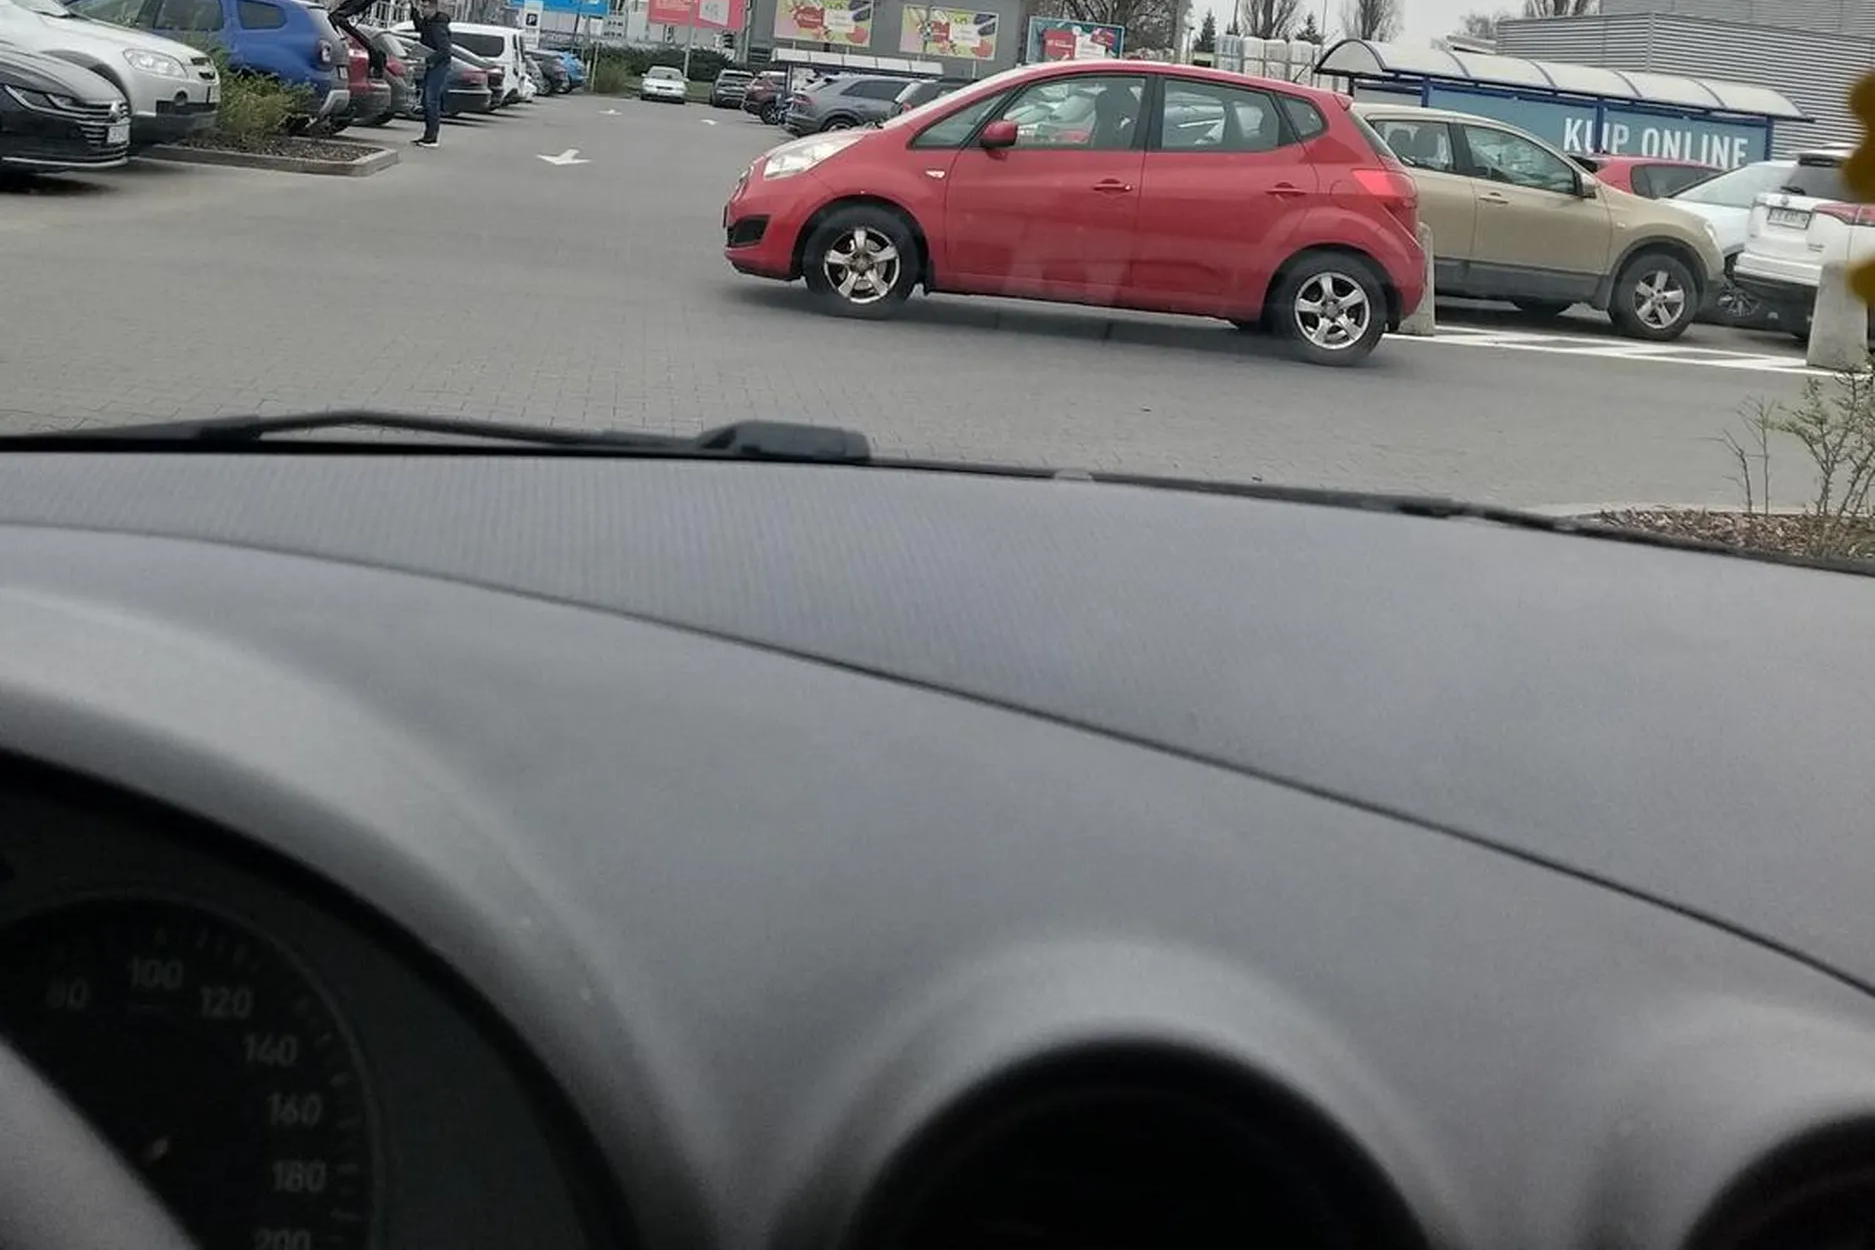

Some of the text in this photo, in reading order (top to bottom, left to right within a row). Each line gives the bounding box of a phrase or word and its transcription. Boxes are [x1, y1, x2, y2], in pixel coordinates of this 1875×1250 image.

[1563, 117, 1748, 170] KUP ONLINE
[127, 955, 184, 990] 100
[200, 986, 254, 1019] 120
[242, 1033, 298, 1066] 140
[267, 1092, 323, 1126] 160
[272, 1160, 328, 1193] 180
[254, 1229, 312, 1250] 200
